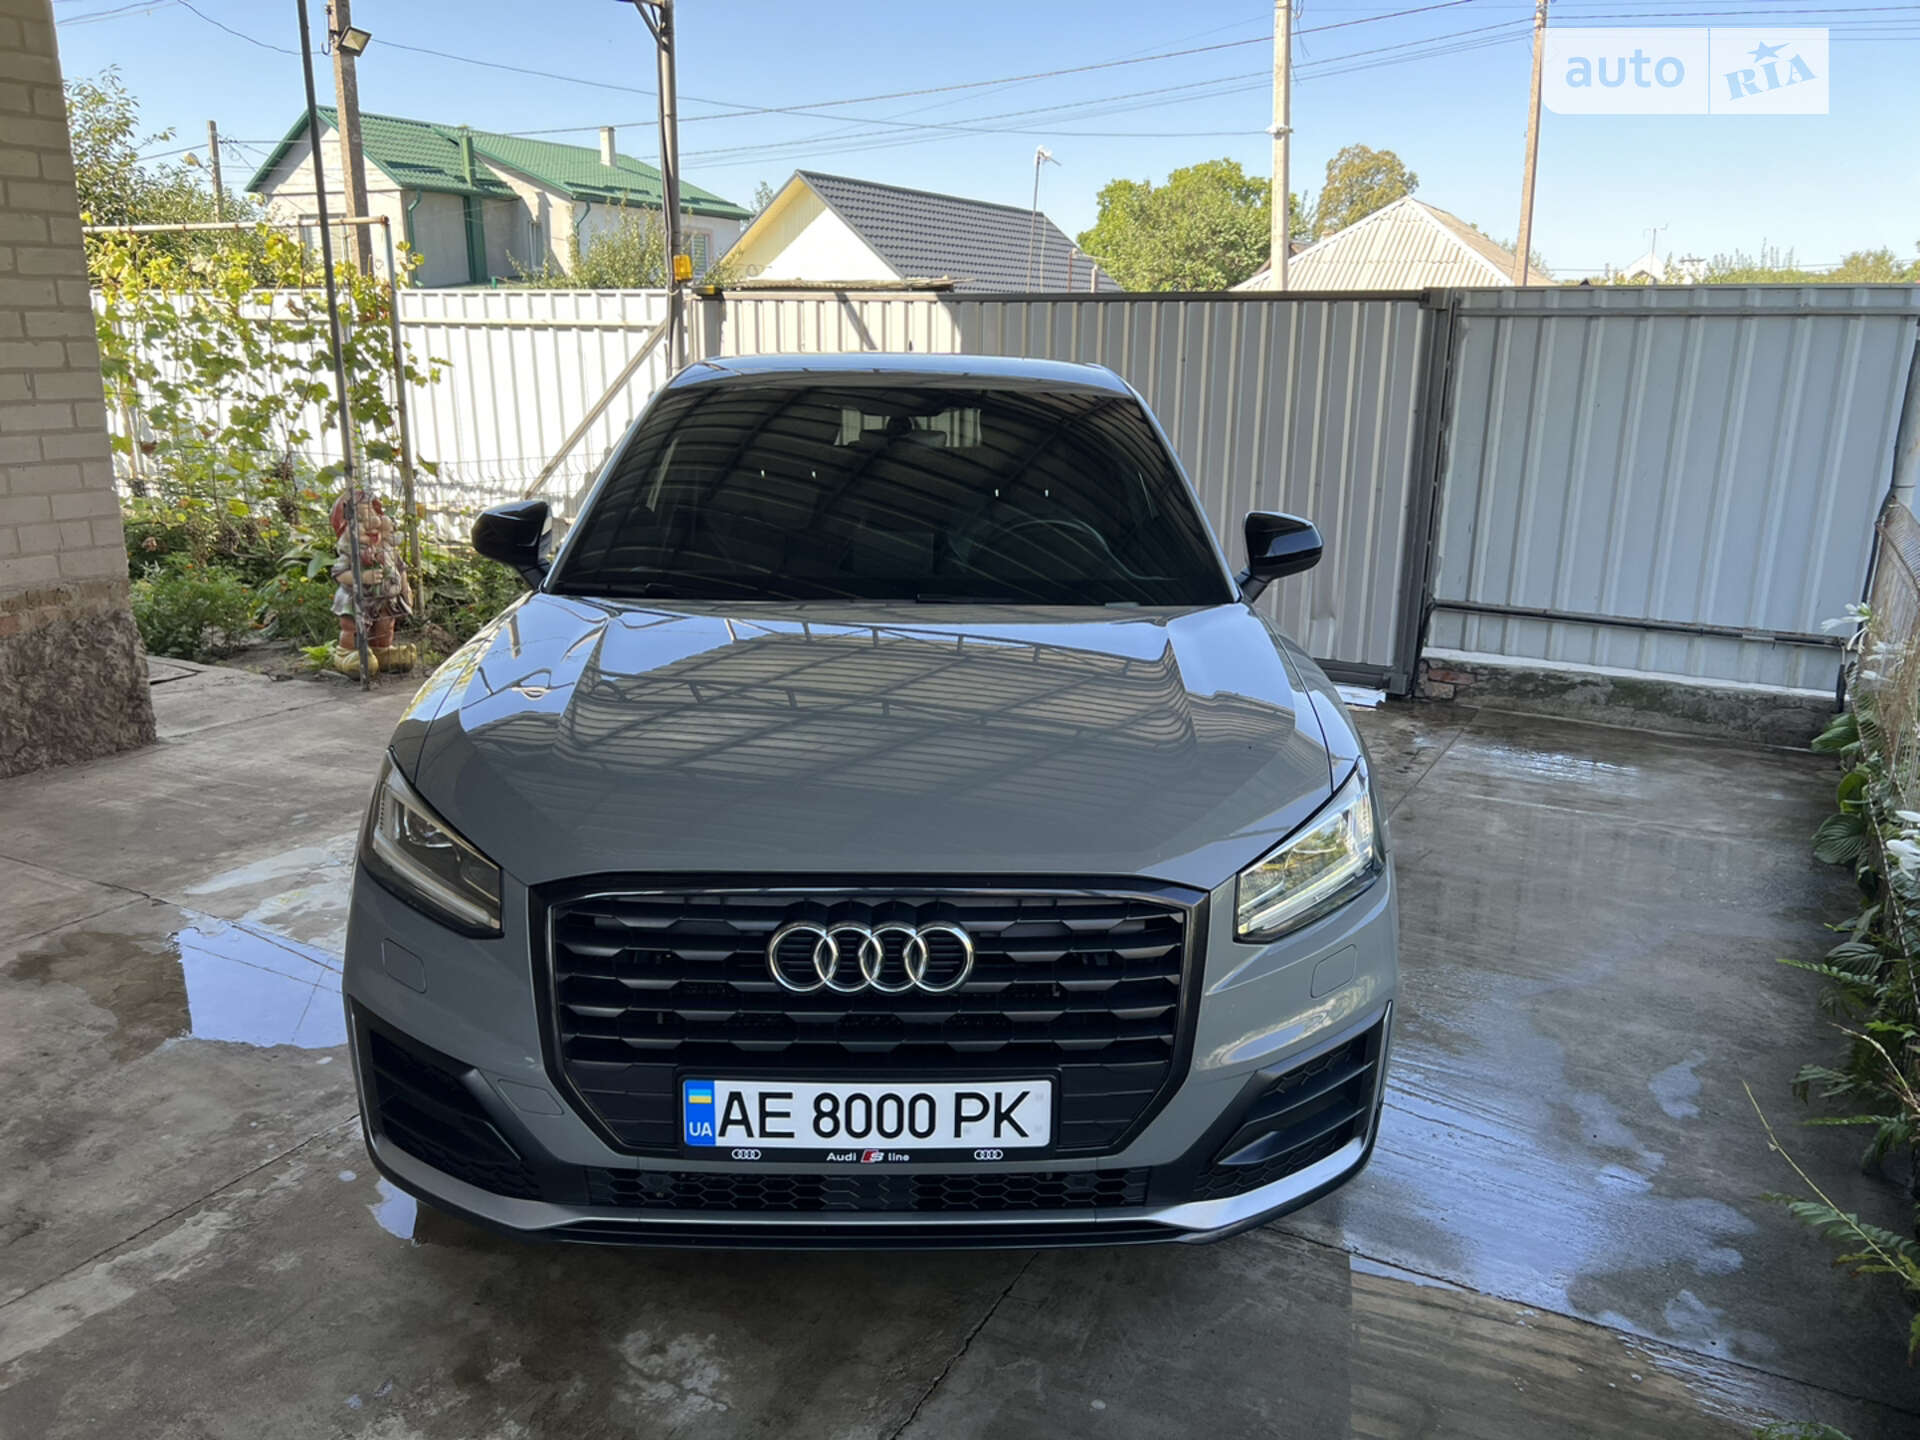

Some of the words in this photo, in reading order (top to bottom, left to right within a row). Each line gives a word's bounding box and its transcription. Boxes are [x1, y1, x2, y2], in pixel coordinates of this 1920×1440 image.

[717, 1091, 795, 1139] AE
[812, 1092, 937, 1139] 8000
[953, 1091, 1031, 1139] PK
[689, 1121, 713, 1137] UA
[826, 1151, 857, 1163] Audi
[887, 1151, 910, 1163] line
